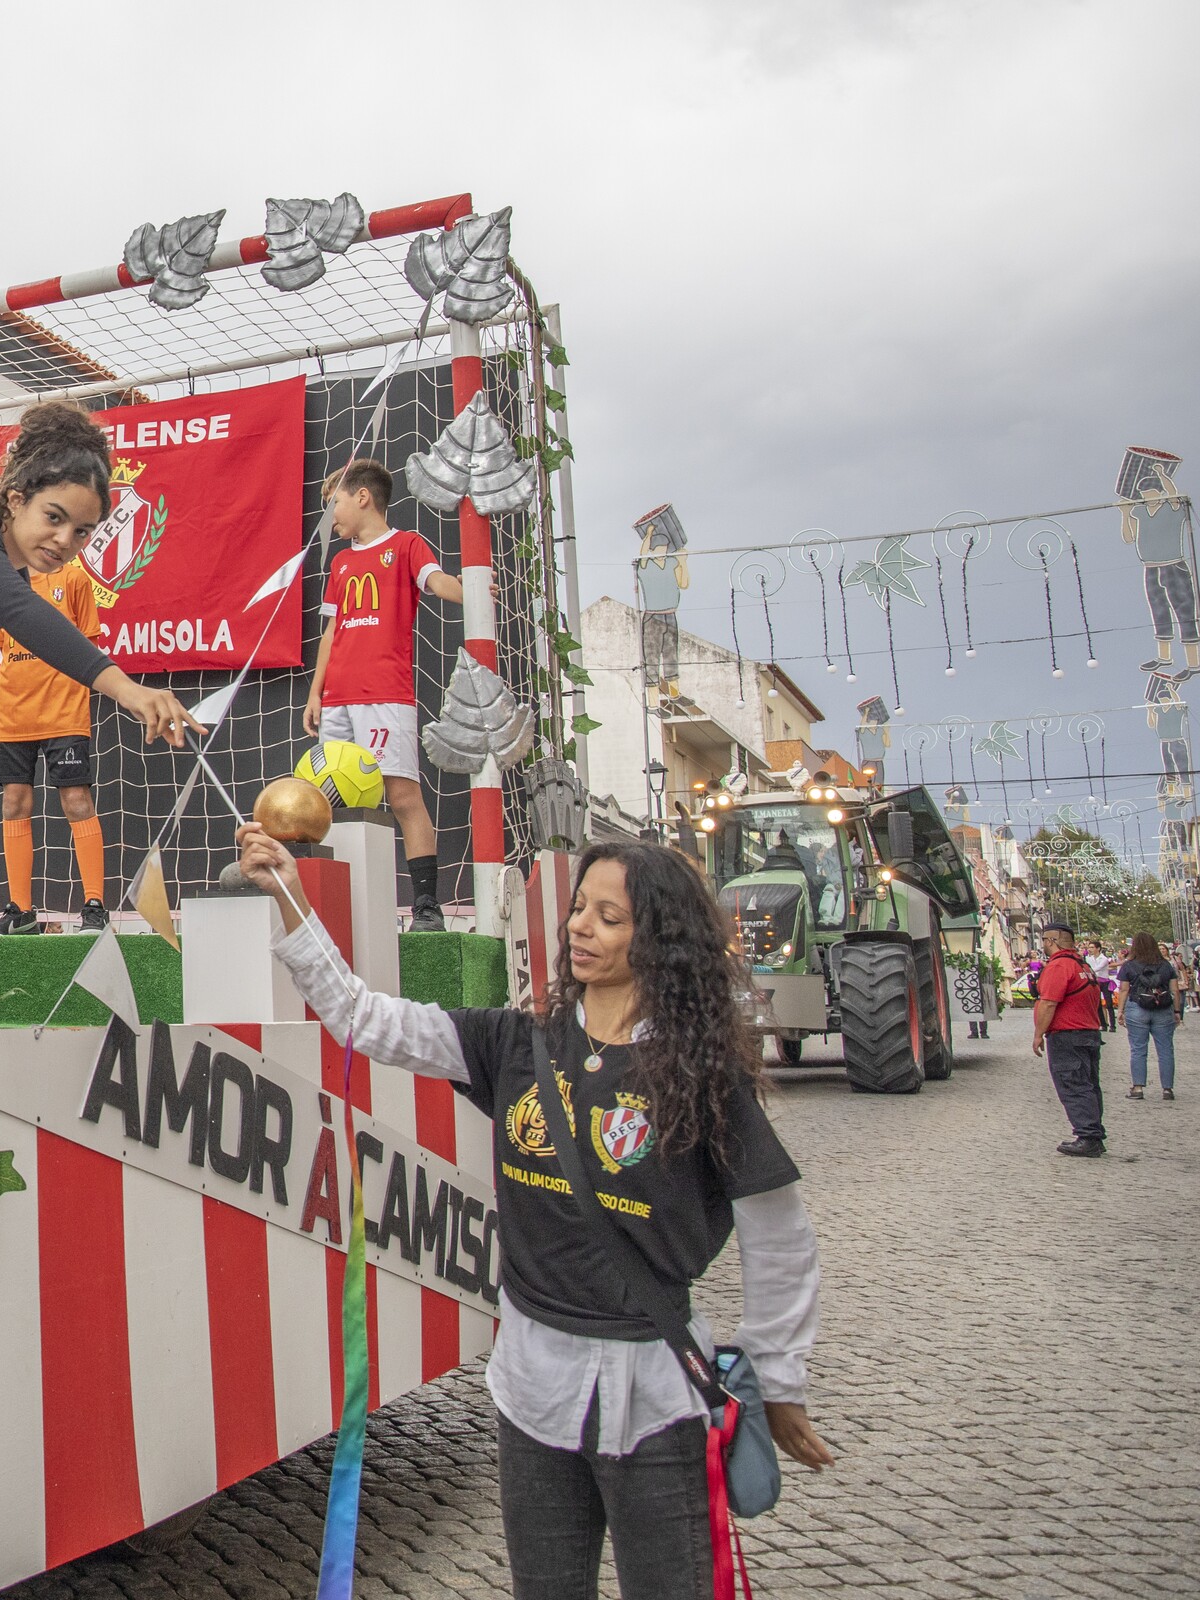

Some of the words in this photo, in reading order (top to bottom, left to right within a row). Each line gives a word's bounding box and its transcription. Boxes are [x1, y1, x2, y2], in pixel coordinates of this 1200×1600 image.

[100, 414, 231, 450] ELENSE
[92, 507, 134, 554] P.F.C.
[97, 618, 234, 656] CAMISOLA
[7, 651, 37, 663] Palme
[370, 728, 389, 748] 77
[609, 1121, 640, 1141] P.F.C.
[79, 1013, 294, 1206] AMOR
[300, 1091, 343, 1245] À
[349, 1130, 500, 1306] CAMISO
[530, 1172, 545, 1188] UM
[545, 1175, 574, 1195] CASTE
[618, 1197, 653, 1219] CLUBE
